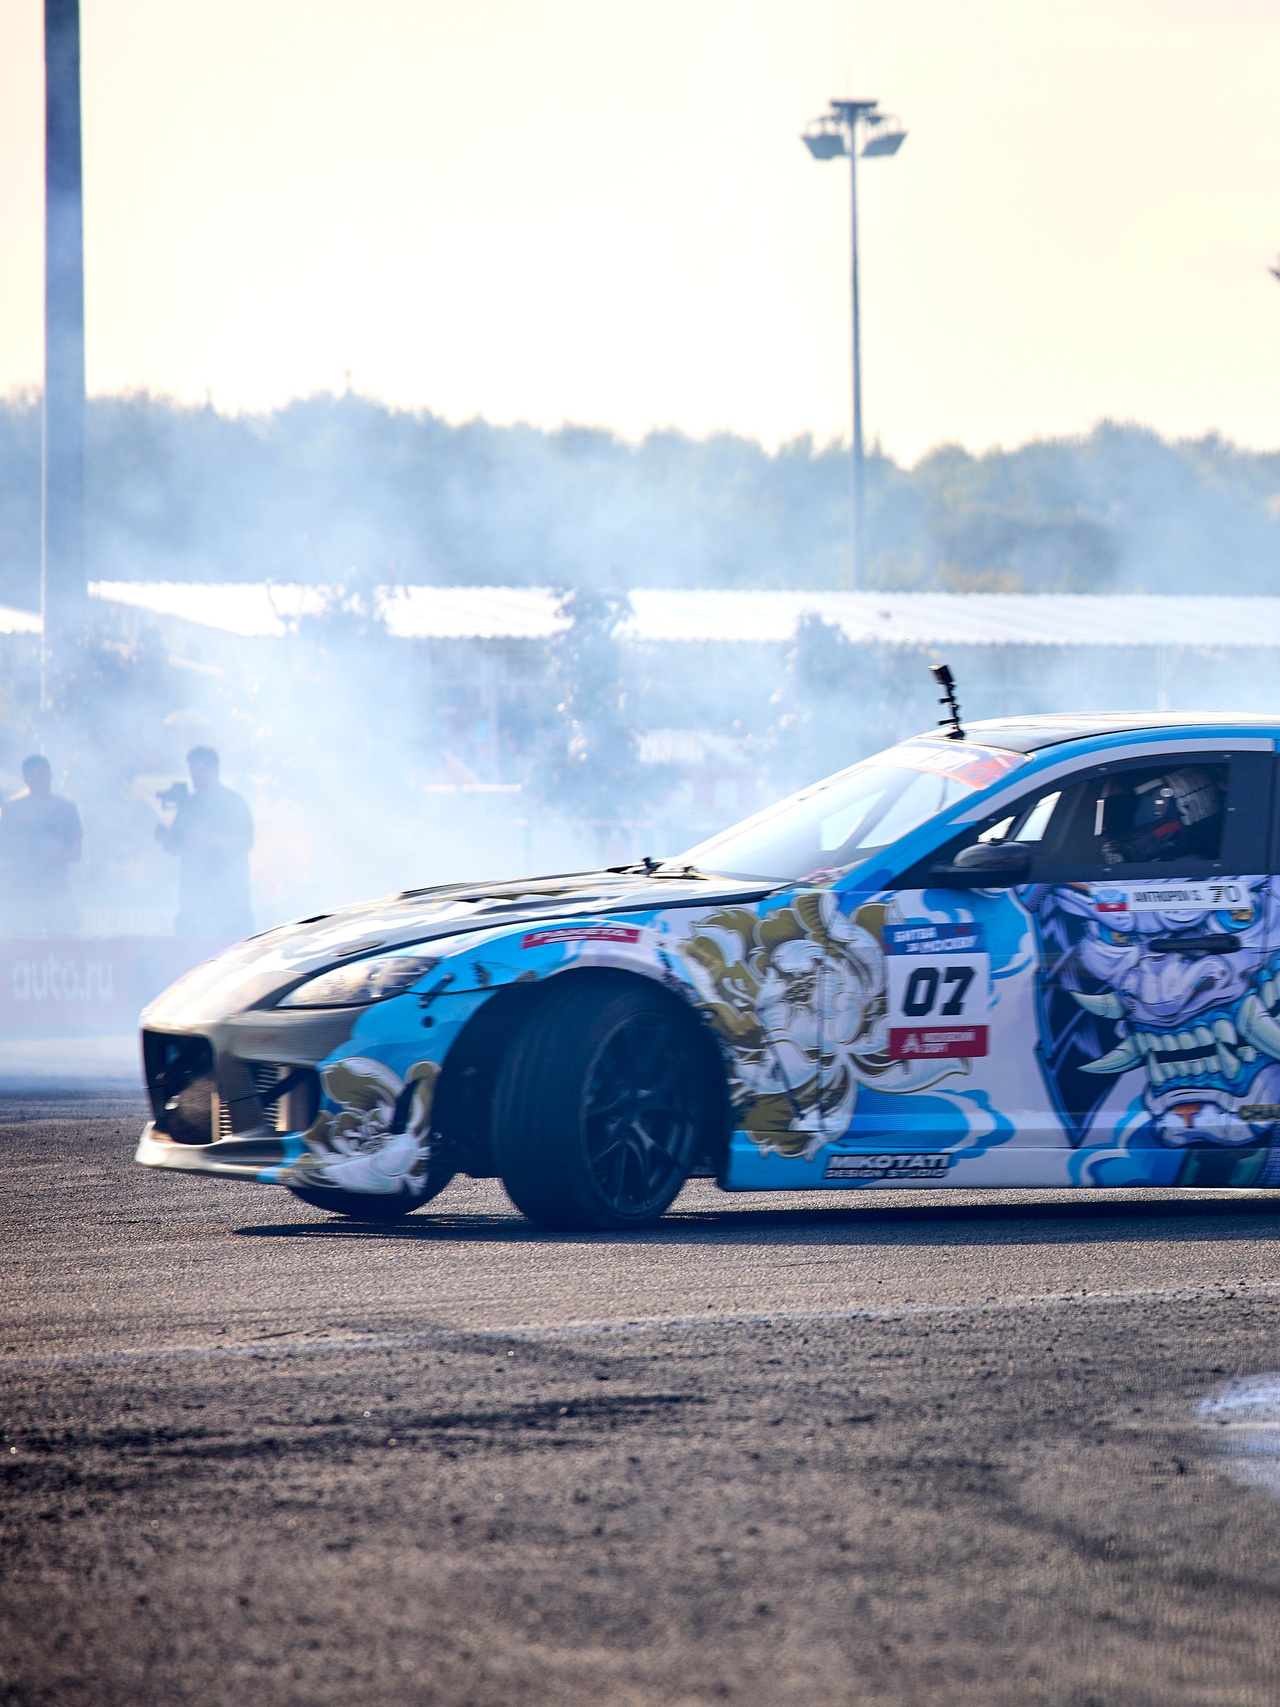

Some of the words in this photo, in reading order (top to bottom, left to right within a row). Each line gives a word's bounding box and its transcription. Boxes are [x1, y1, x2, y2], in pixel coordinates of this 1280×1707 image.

[1207, 885, 1241, 902] 70
[13, 953, 113, 1000] auto.ru
[903, 966, 977, 1016] 07
[830, 1155, 948, 1168] MIKOTATI
